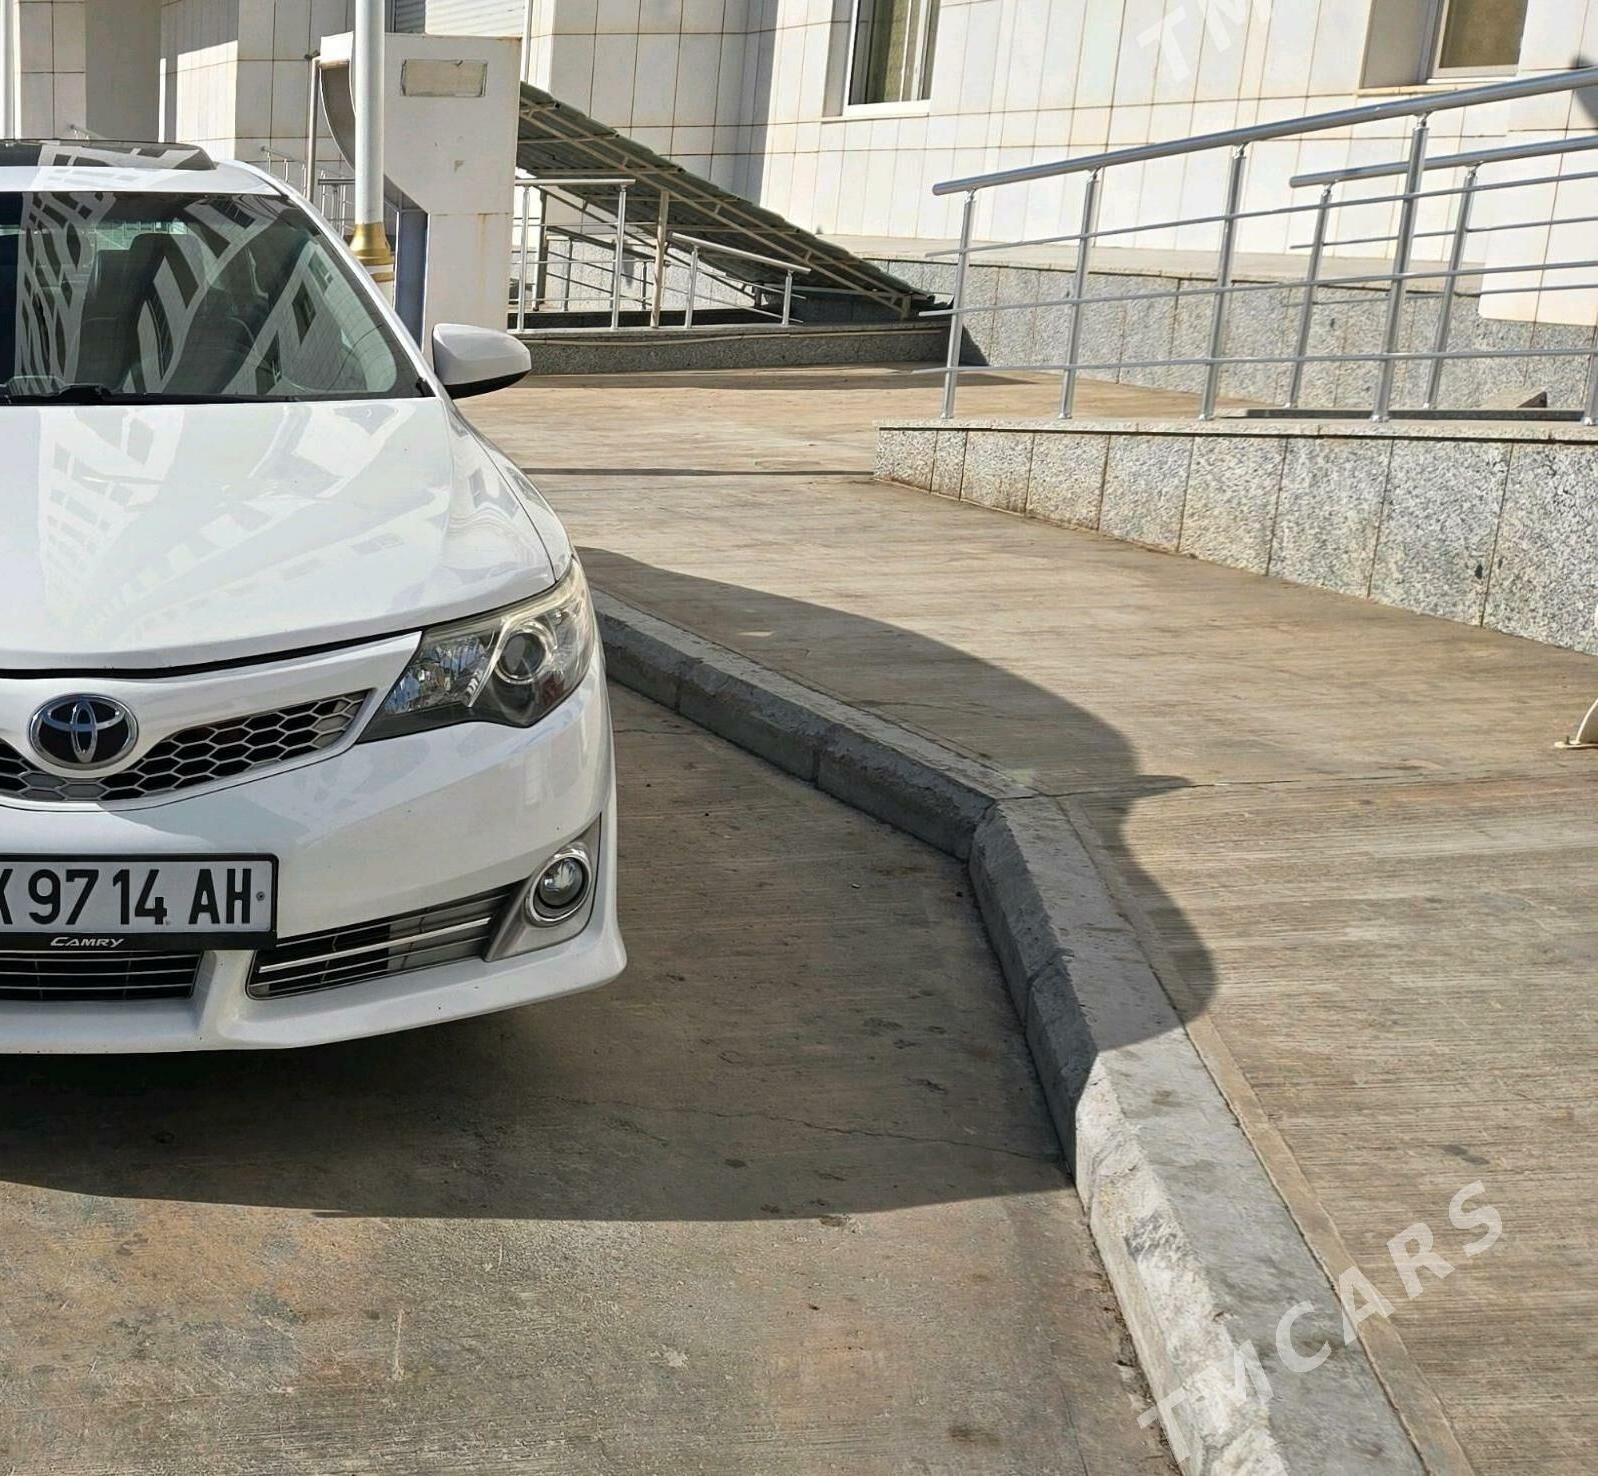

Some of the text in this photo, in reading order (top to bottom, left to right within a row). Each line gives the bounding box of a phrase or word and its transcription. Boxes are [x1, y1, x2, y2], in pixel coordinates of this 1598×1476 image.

[28, 868, 100, 925] 97
[113, 868, 168, 926] 14
[188, 868, 252, 925] AH
[50, 936, 124, 948] CAMRY
